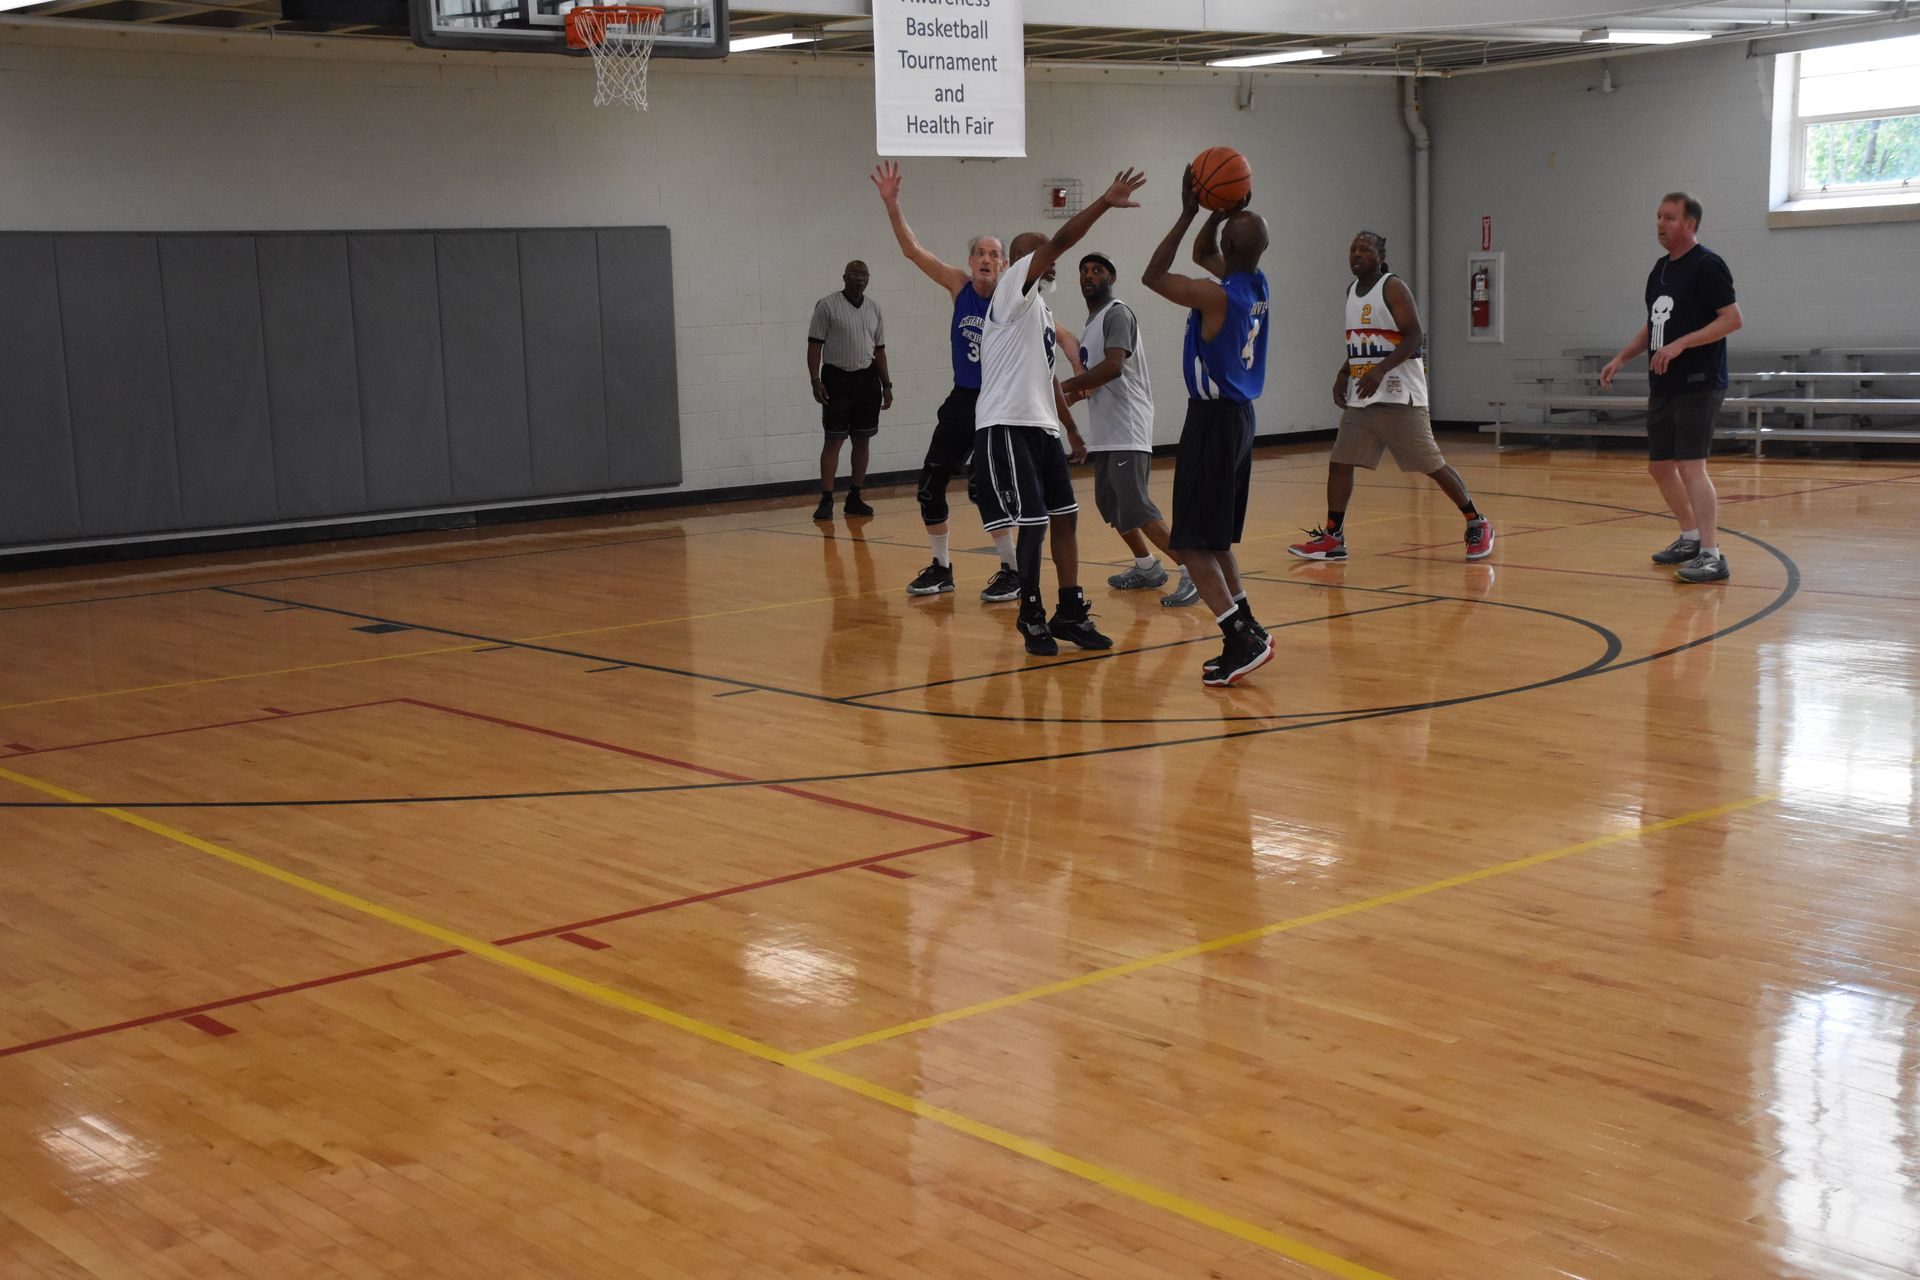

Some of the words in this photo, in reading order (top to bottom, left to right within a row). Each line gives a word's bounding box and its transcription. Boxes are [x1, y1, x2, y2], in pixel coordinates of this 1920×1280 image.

[906, 17, 988, 40] Basketball
[898, 49, 998, 72] Tournament
[934, 83, 965, 103] and
[906, 114, 960, 135] Health
[965, 116, 995, 135] Fair
[1360, 304, 1372, 324] 2
